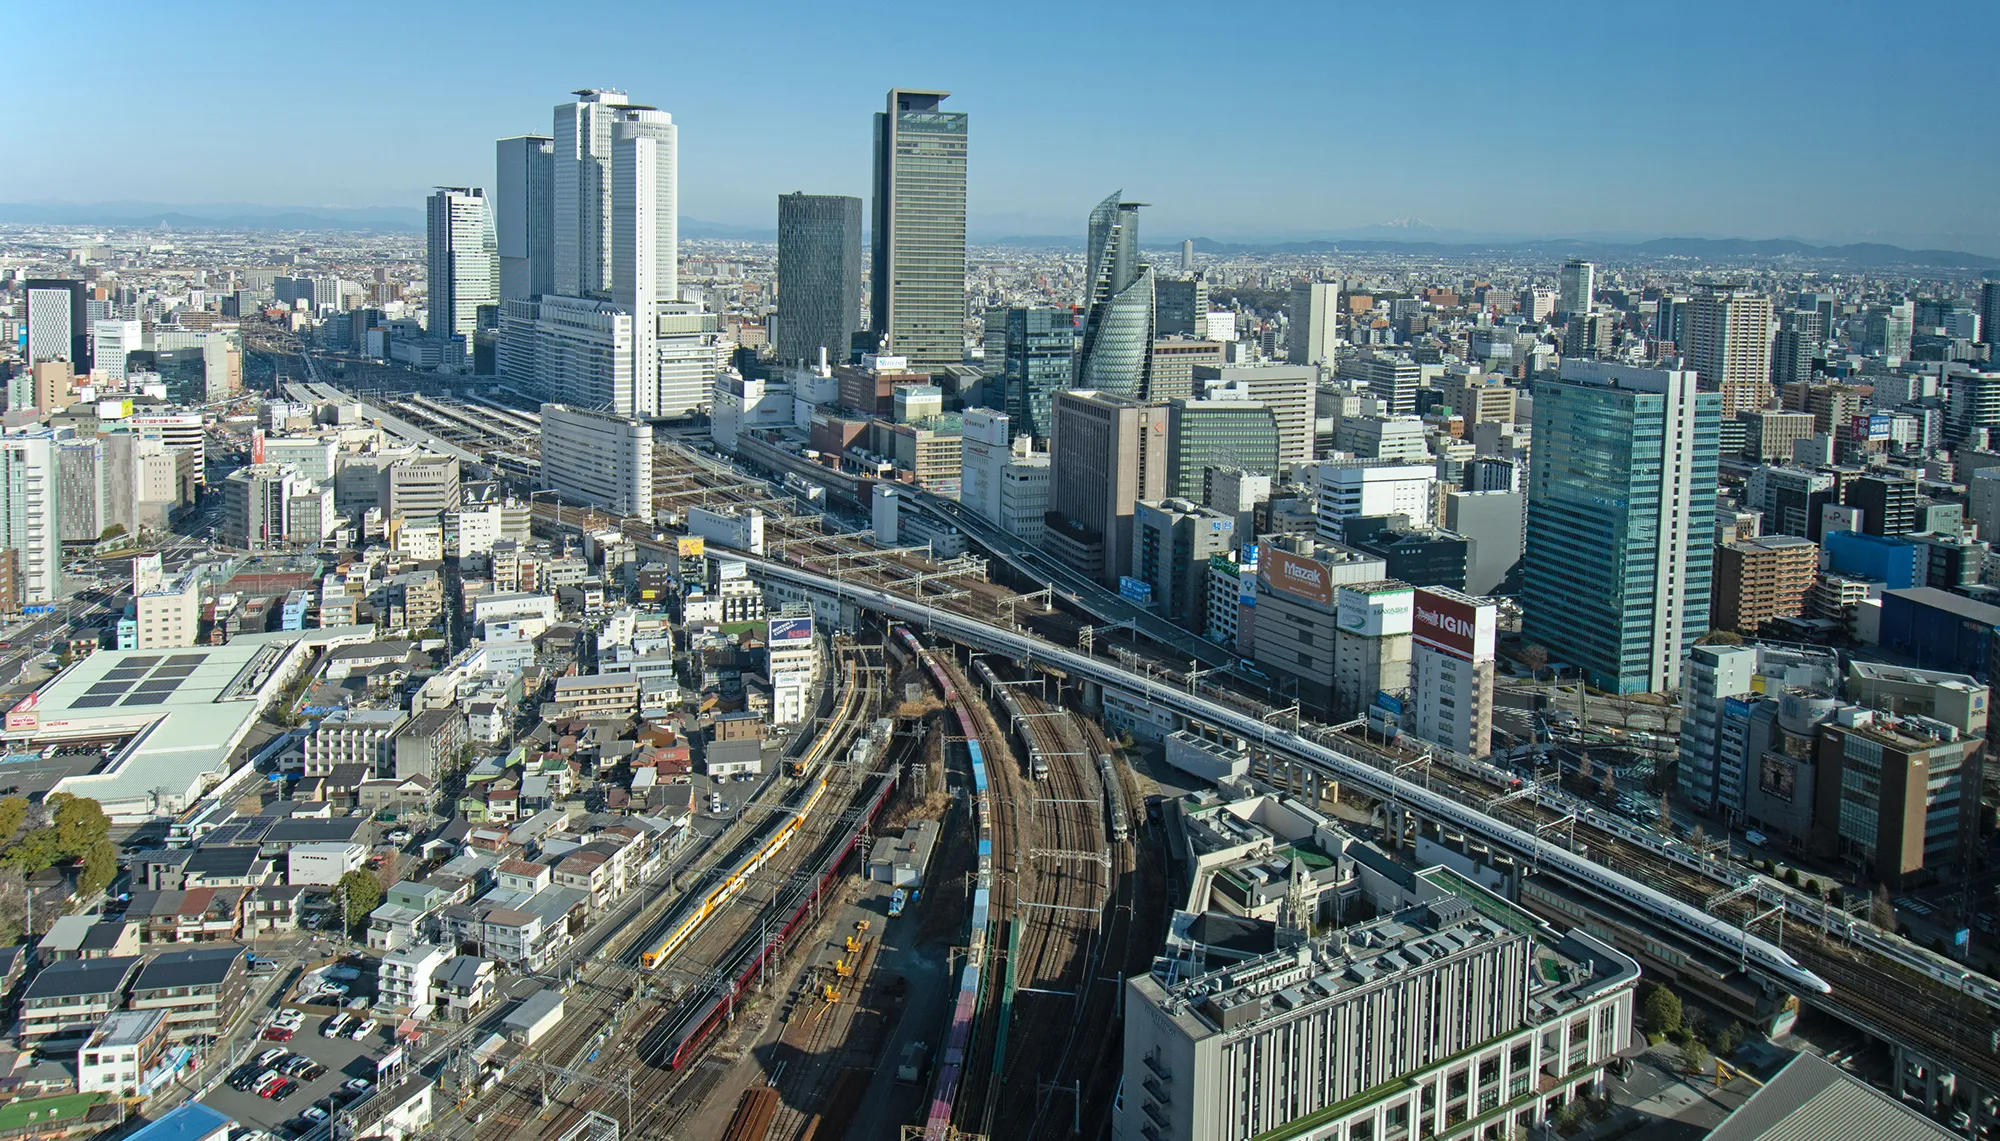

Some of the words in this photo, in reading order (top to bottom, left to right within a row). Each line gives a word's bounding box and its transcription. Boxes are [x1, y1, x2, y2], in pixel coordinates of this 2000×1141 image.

[1284, 561, 1321, 584] Mazak
[1373, 606, 1409, 616] HAYASHI
[1439, 613, 1474, 639] IGIN
[787, 630, 811, 639] NSK
